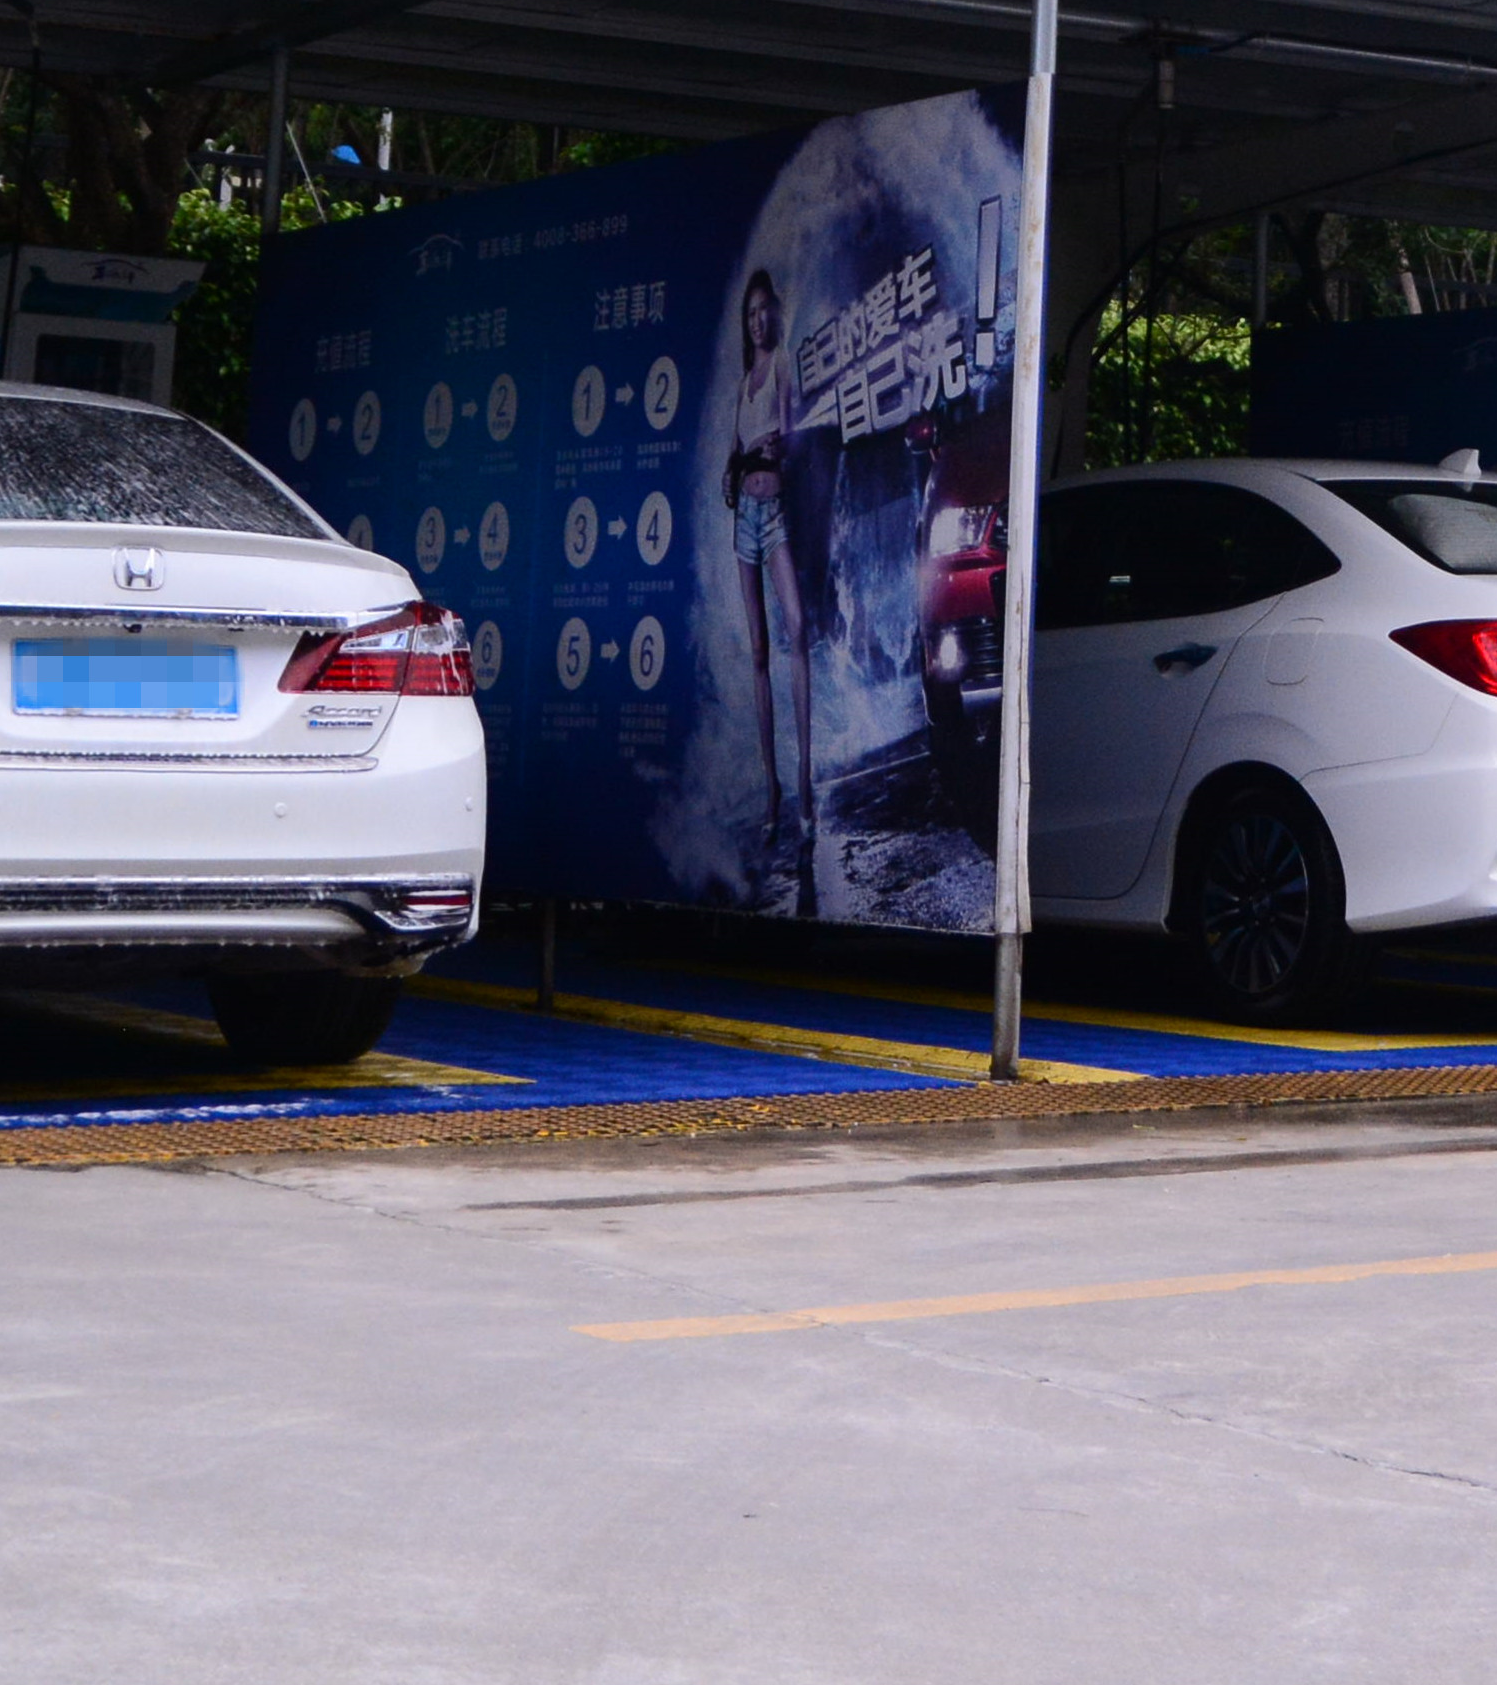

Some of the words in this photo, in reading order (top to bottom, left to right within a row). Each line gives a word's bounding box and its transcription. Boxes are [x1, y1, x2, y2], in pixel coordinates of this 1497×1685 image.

[445, 306, 508, 354] 洗车流程
[593, 281, 666, 332] 注意事项
[797, 245, 936, 397] 自己的爱车
